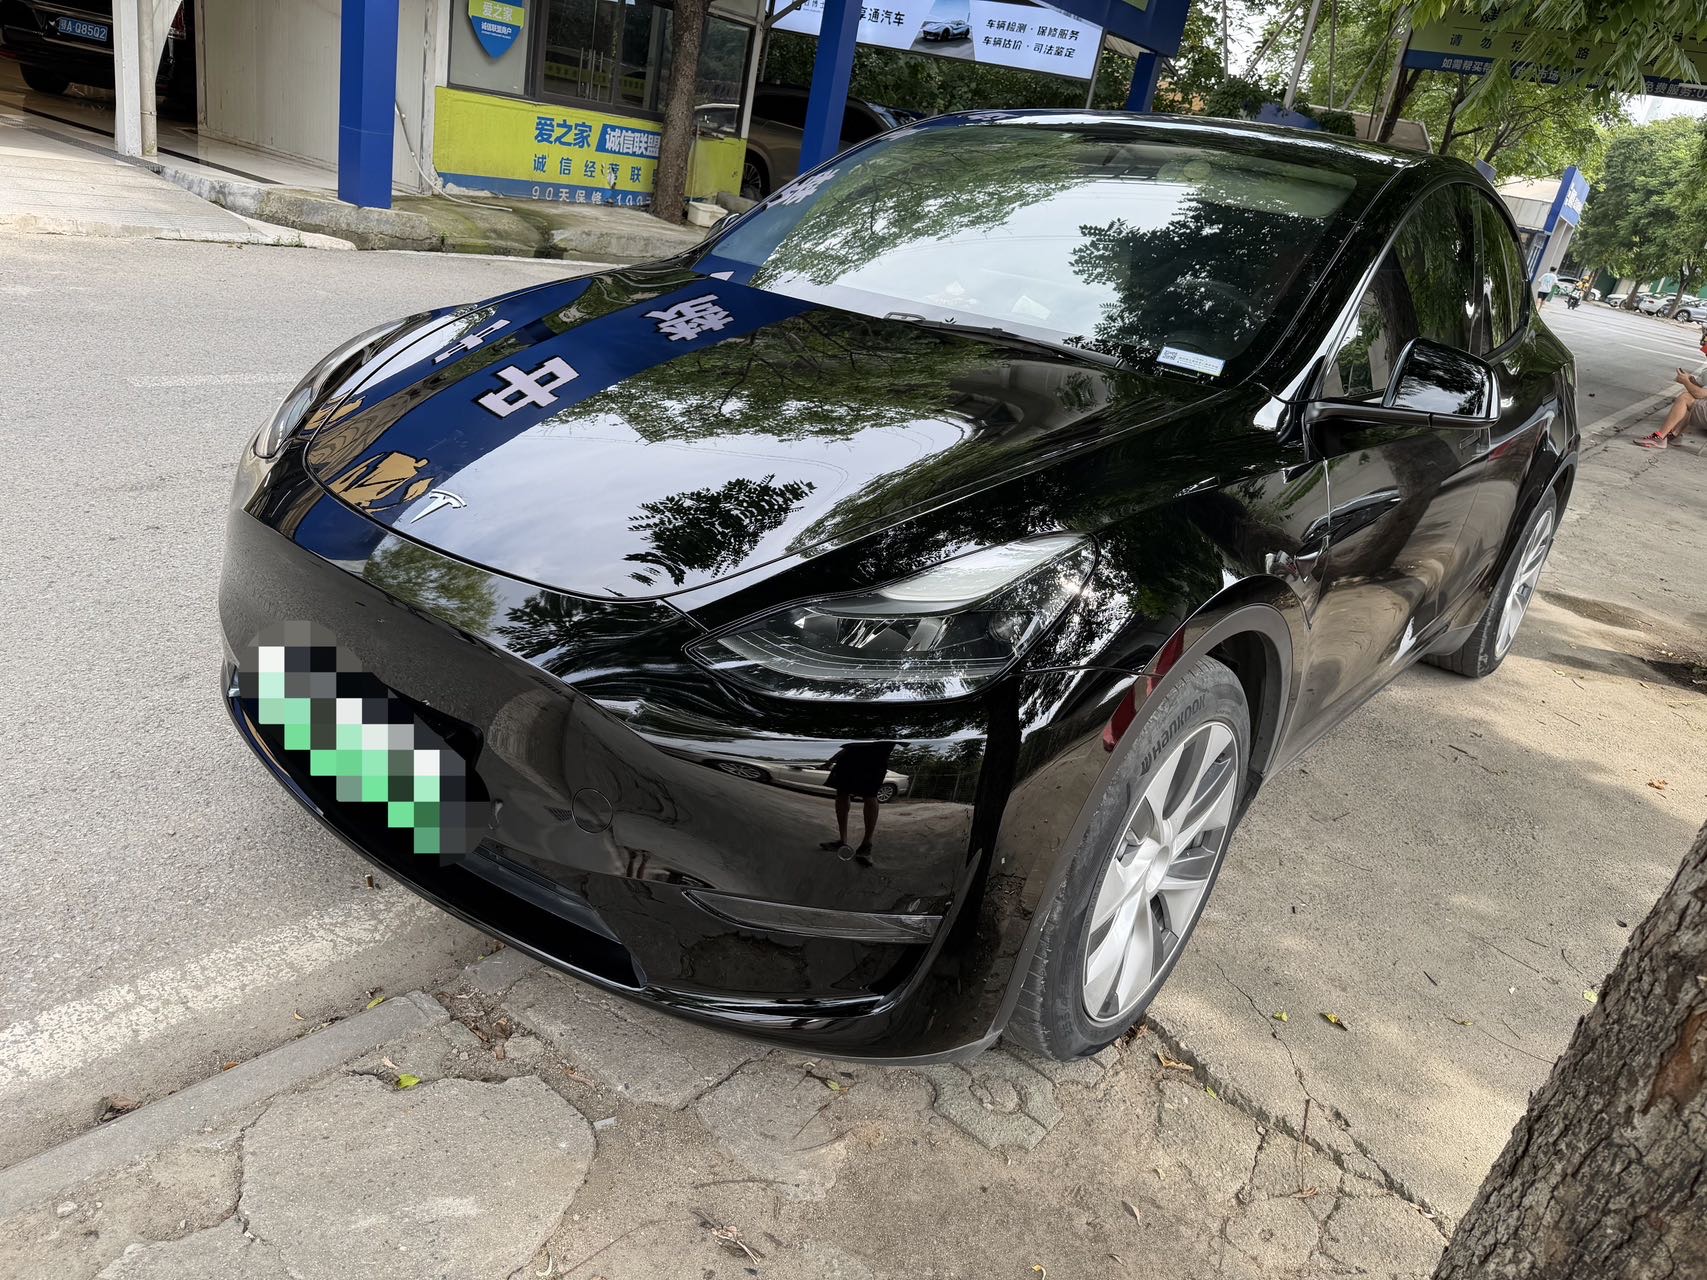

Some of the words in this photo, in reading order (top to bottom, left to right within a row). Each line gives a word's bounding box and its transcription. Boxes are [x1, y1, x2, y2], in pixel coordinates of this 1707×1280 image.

[482, 1, 513, 21] 爱之家
[534, 116, 593, 149] 爱之家
[605, 127, 661, 157] 诚信联盟
[532, 186, 603, 206] 90天保修
